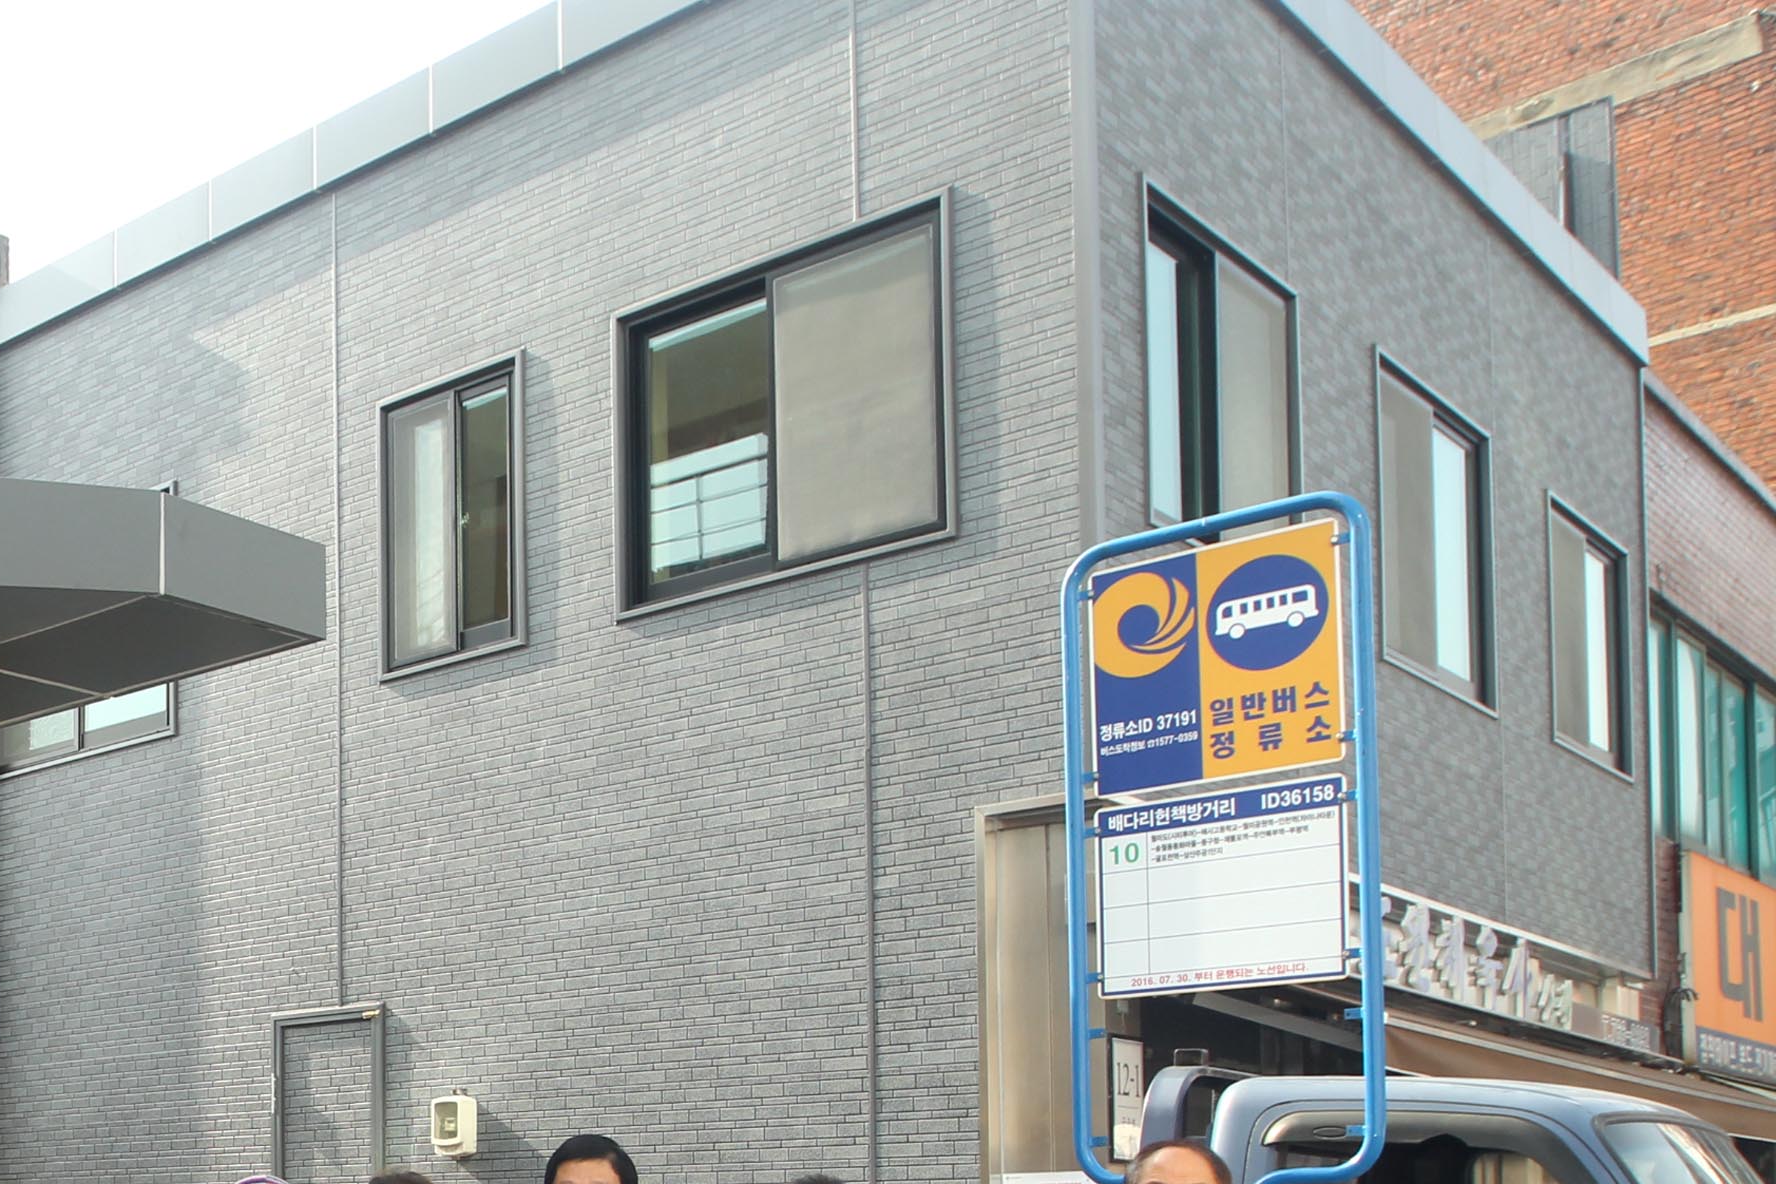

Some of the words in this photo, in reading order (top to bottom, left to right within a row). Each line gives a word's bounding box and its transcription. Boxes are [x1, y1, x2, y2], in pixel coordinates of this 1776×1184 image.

[1210, 681, 1331, 727] 일반버스
[1099, 718, 1153, 742] 정류소ID
[1156, 709, 1197, 731] 37191
[1210, 716, 1331, 760] 정류소
[1107, 798, 1236, 833] 배다리헌책방거리
[1261, 784, 1335, 810] ID36158
[1109, 842, 1140, 865] 10
[1116, 1062, 1141, 1098] 12-1
